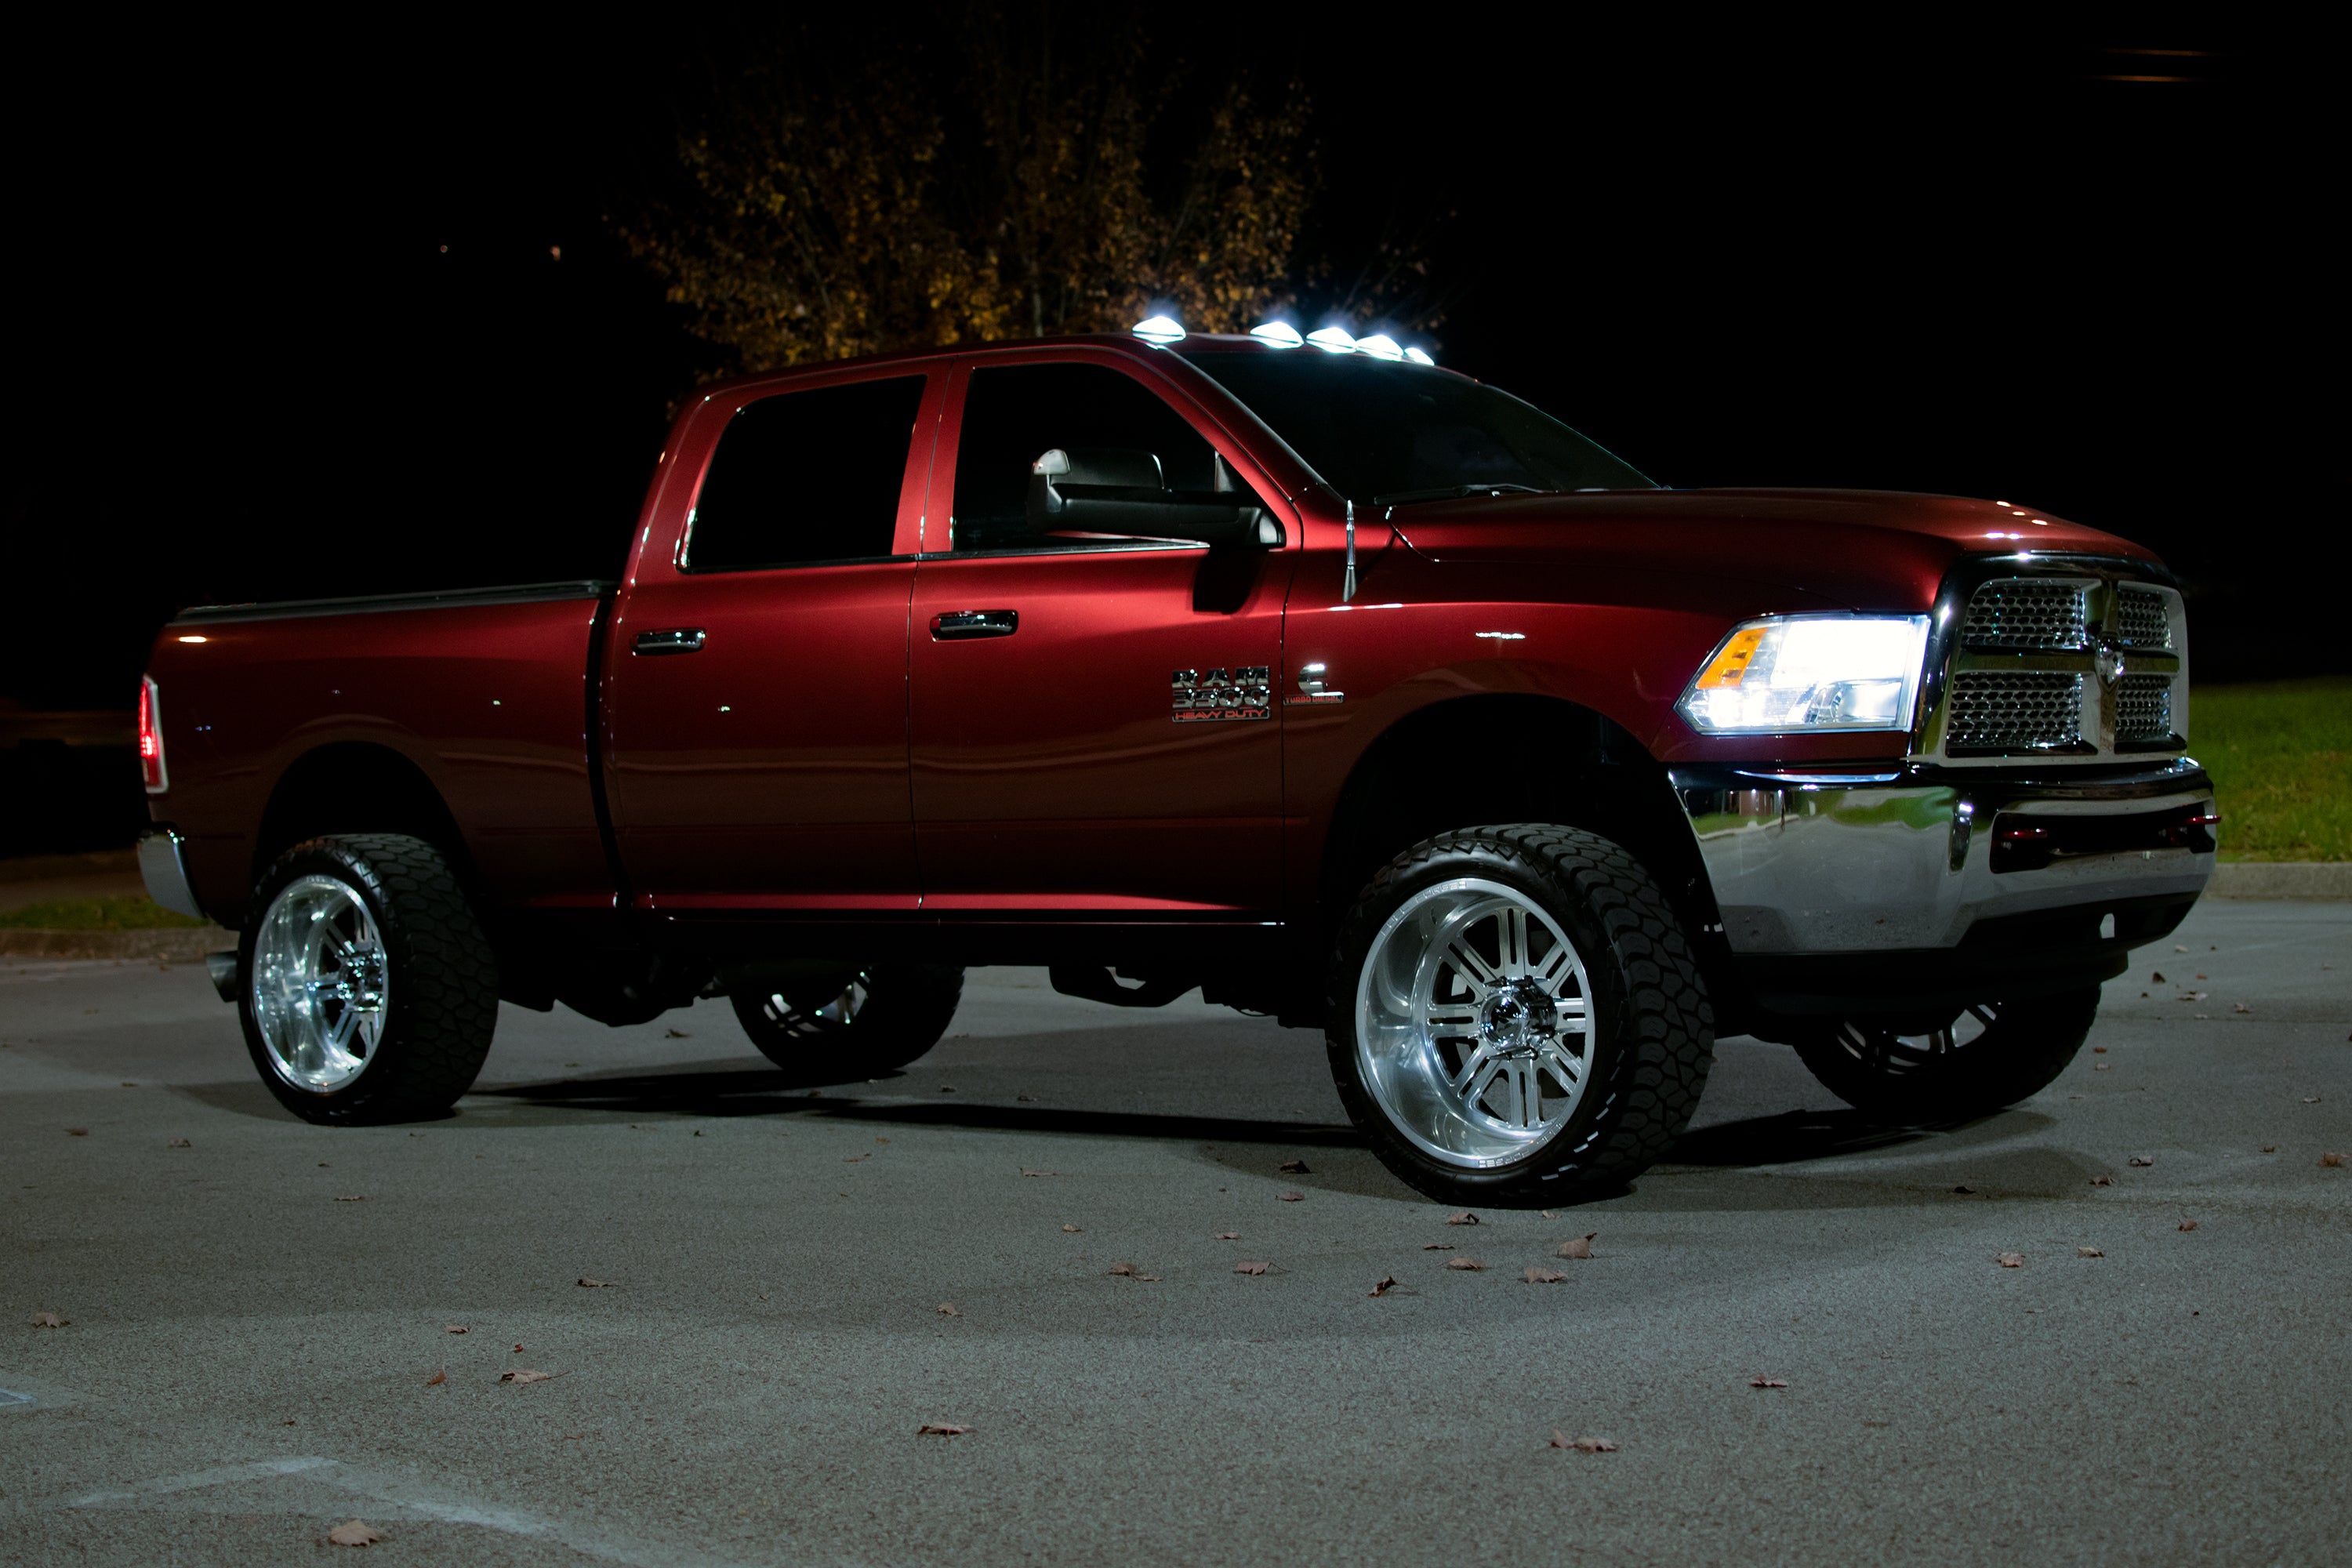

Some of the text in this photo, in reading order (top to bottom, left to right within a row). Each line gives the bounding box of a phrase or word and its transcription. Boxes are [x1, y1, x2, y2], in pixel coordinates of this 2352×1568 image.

[1172, 666, 1269, 688] RAM
[1175, 710, 1265, 720] HEAVY DUTY
